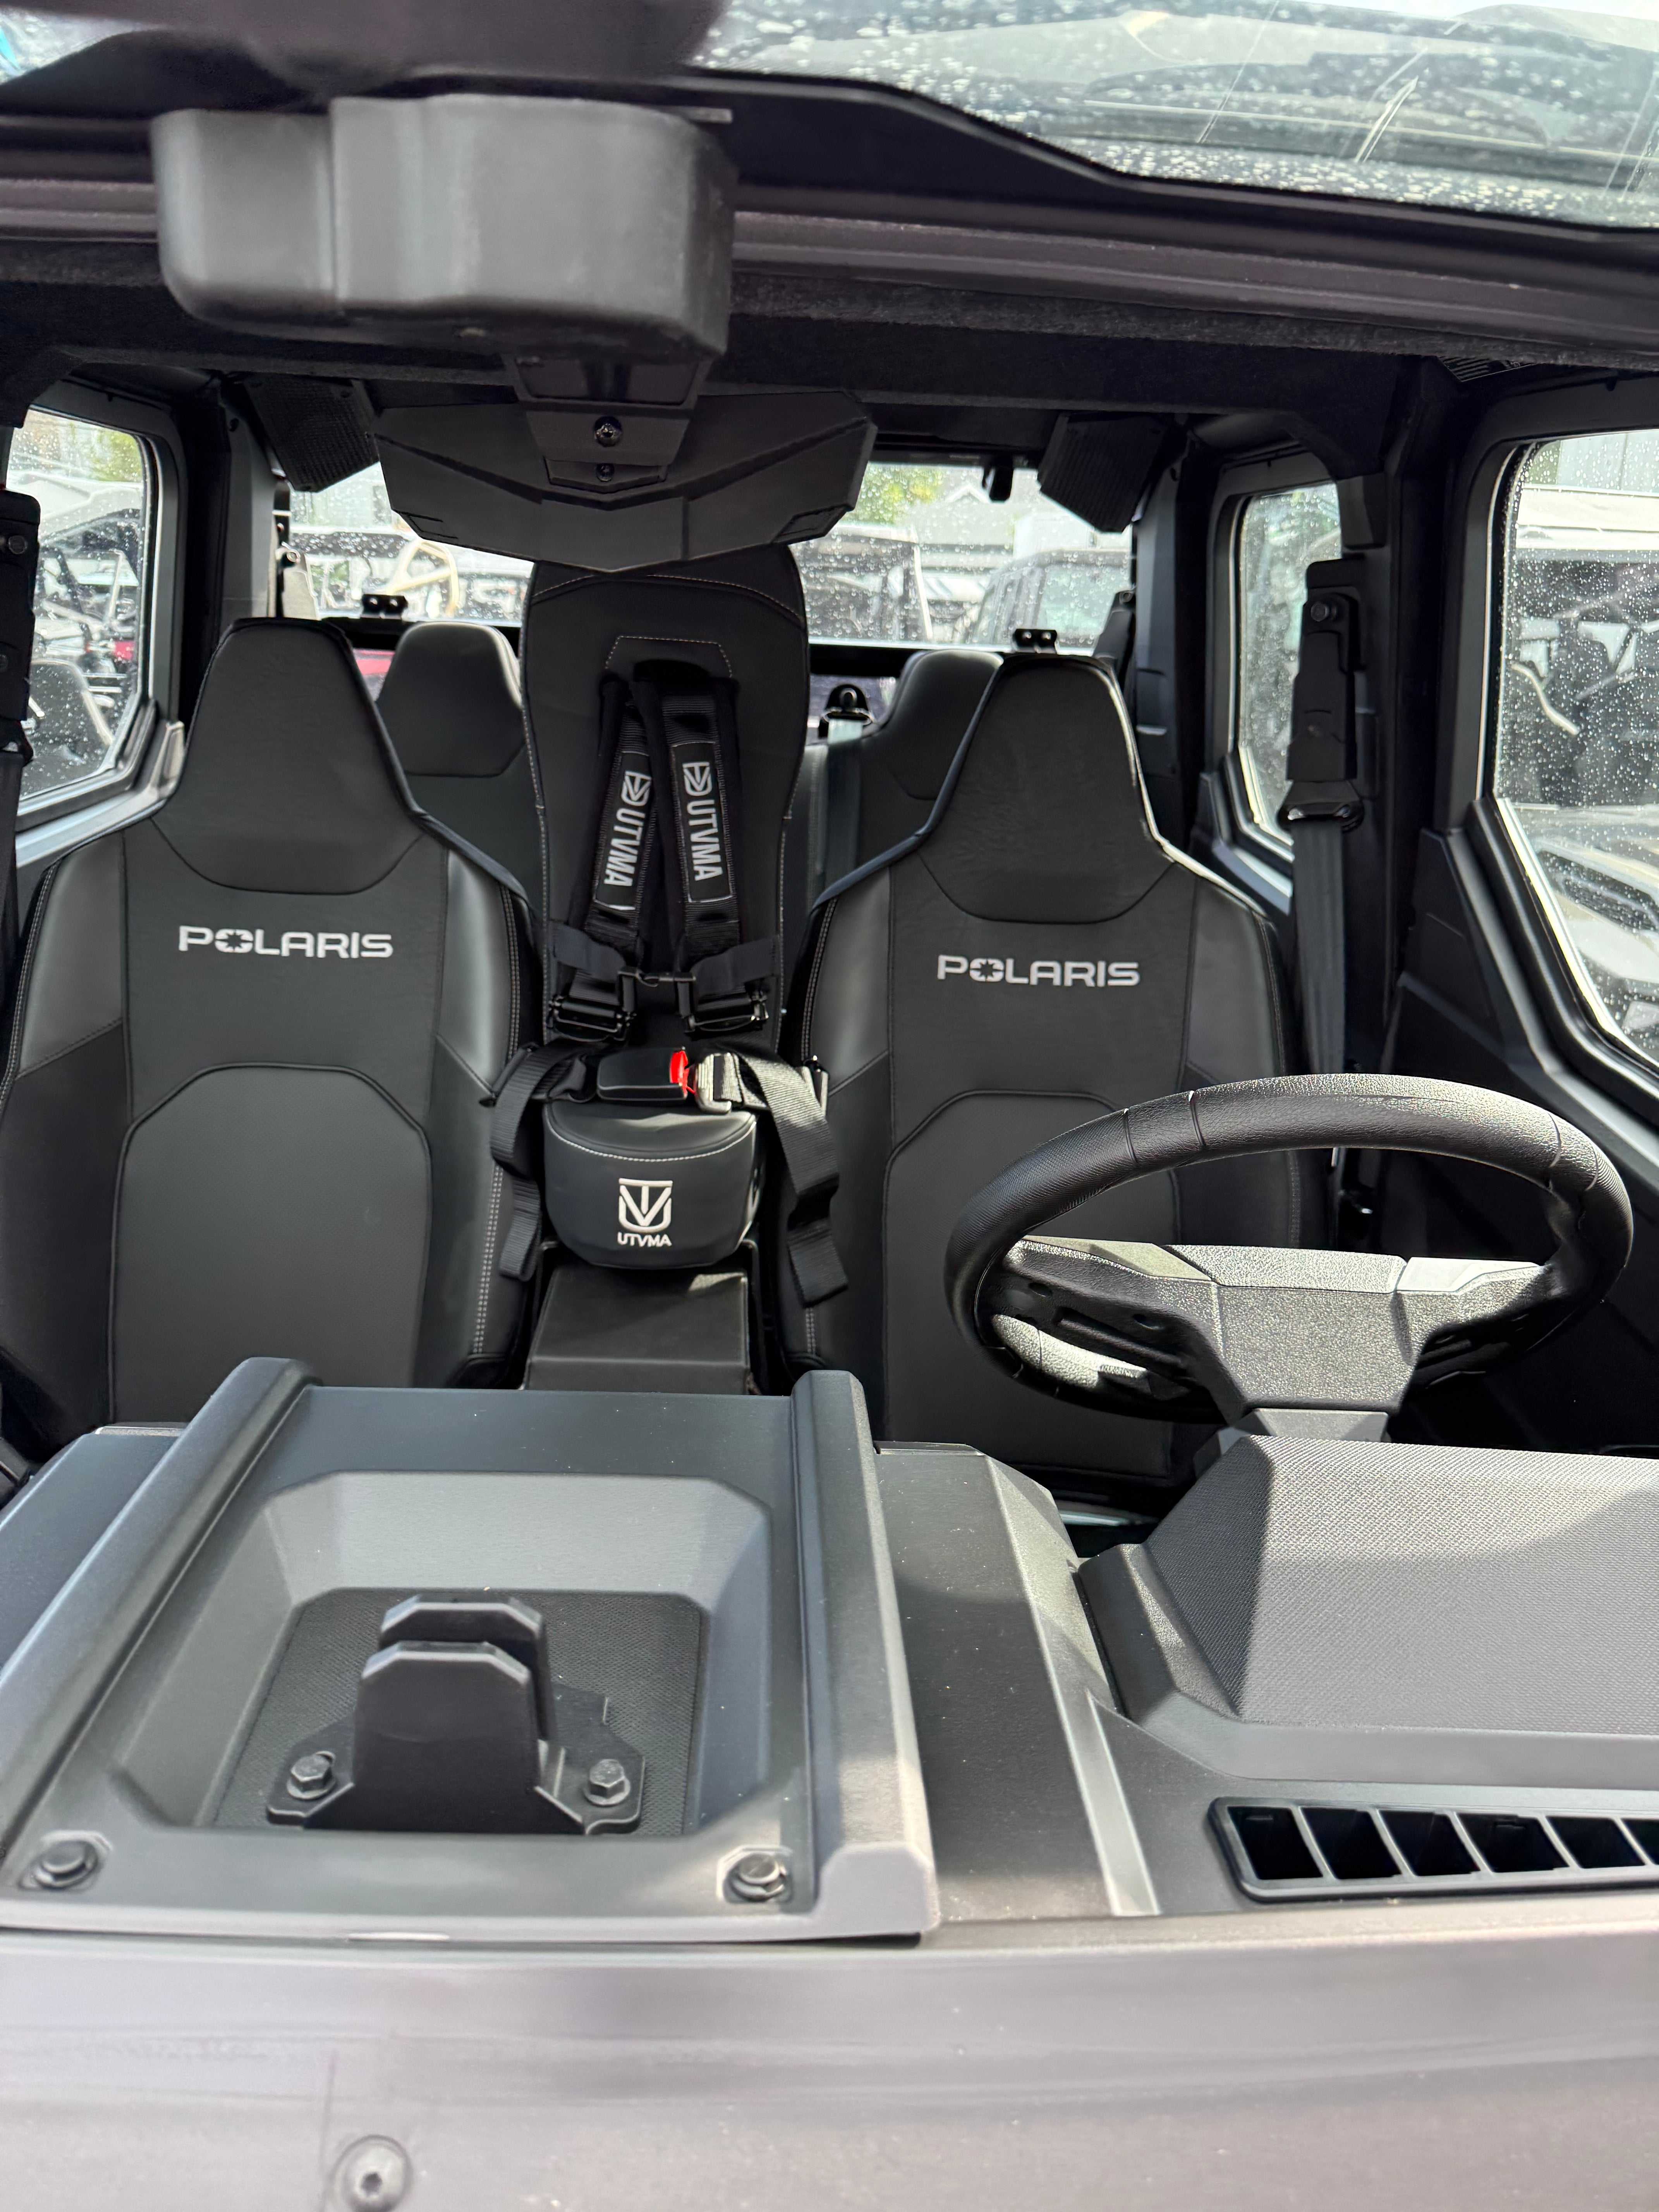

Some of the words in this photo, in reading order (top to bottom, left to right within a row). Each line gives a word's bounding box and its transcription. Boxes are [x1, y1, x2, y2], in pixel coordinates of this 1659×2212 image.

[604, 808, 645, 886] UTVMA
[687, 800, 723, 881] UTVMA
[179, 926, 393, 959] POLARIS
[937, 955, 1139, 987] POLARIS
[617, 1232, 672, 1247] UTVMA
